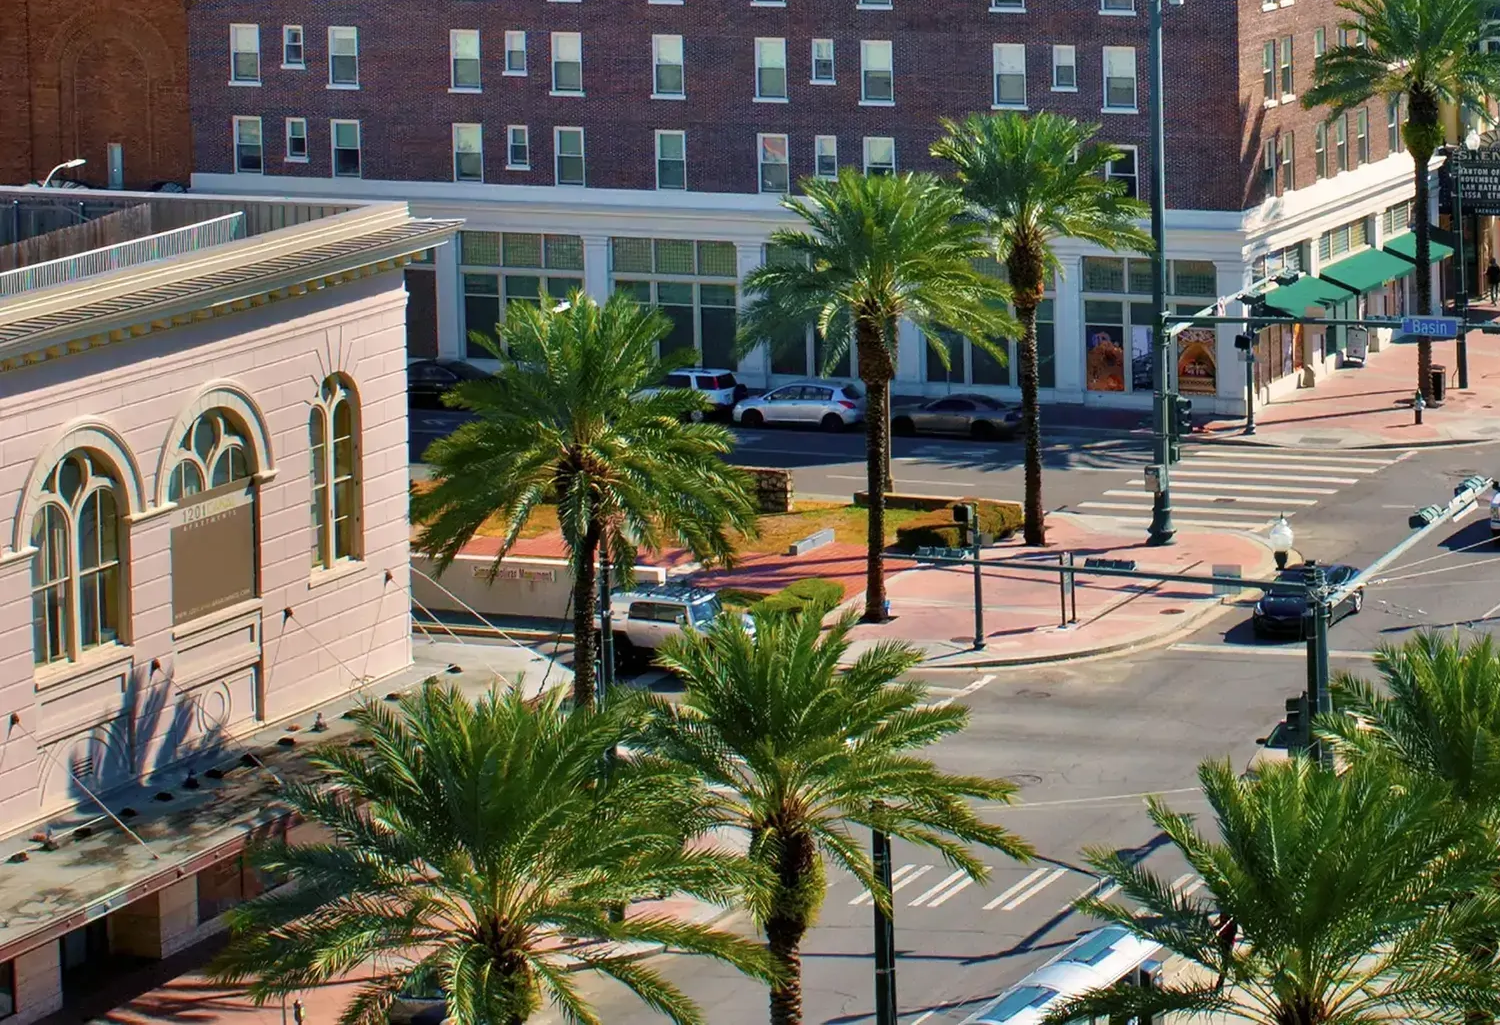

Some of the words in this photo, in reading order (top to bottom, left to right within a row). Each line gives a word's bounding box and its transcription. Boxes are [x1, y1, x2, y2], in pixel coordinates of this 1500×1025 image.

[1458, 168, 1488, 176] HANTOM
[1490, 168, 1500, 176] OF
[1460, 191, 1481, 199] LISSA
[1412, 320, 1448, 335] Basin
[182, 504, 206, 523] 1201
